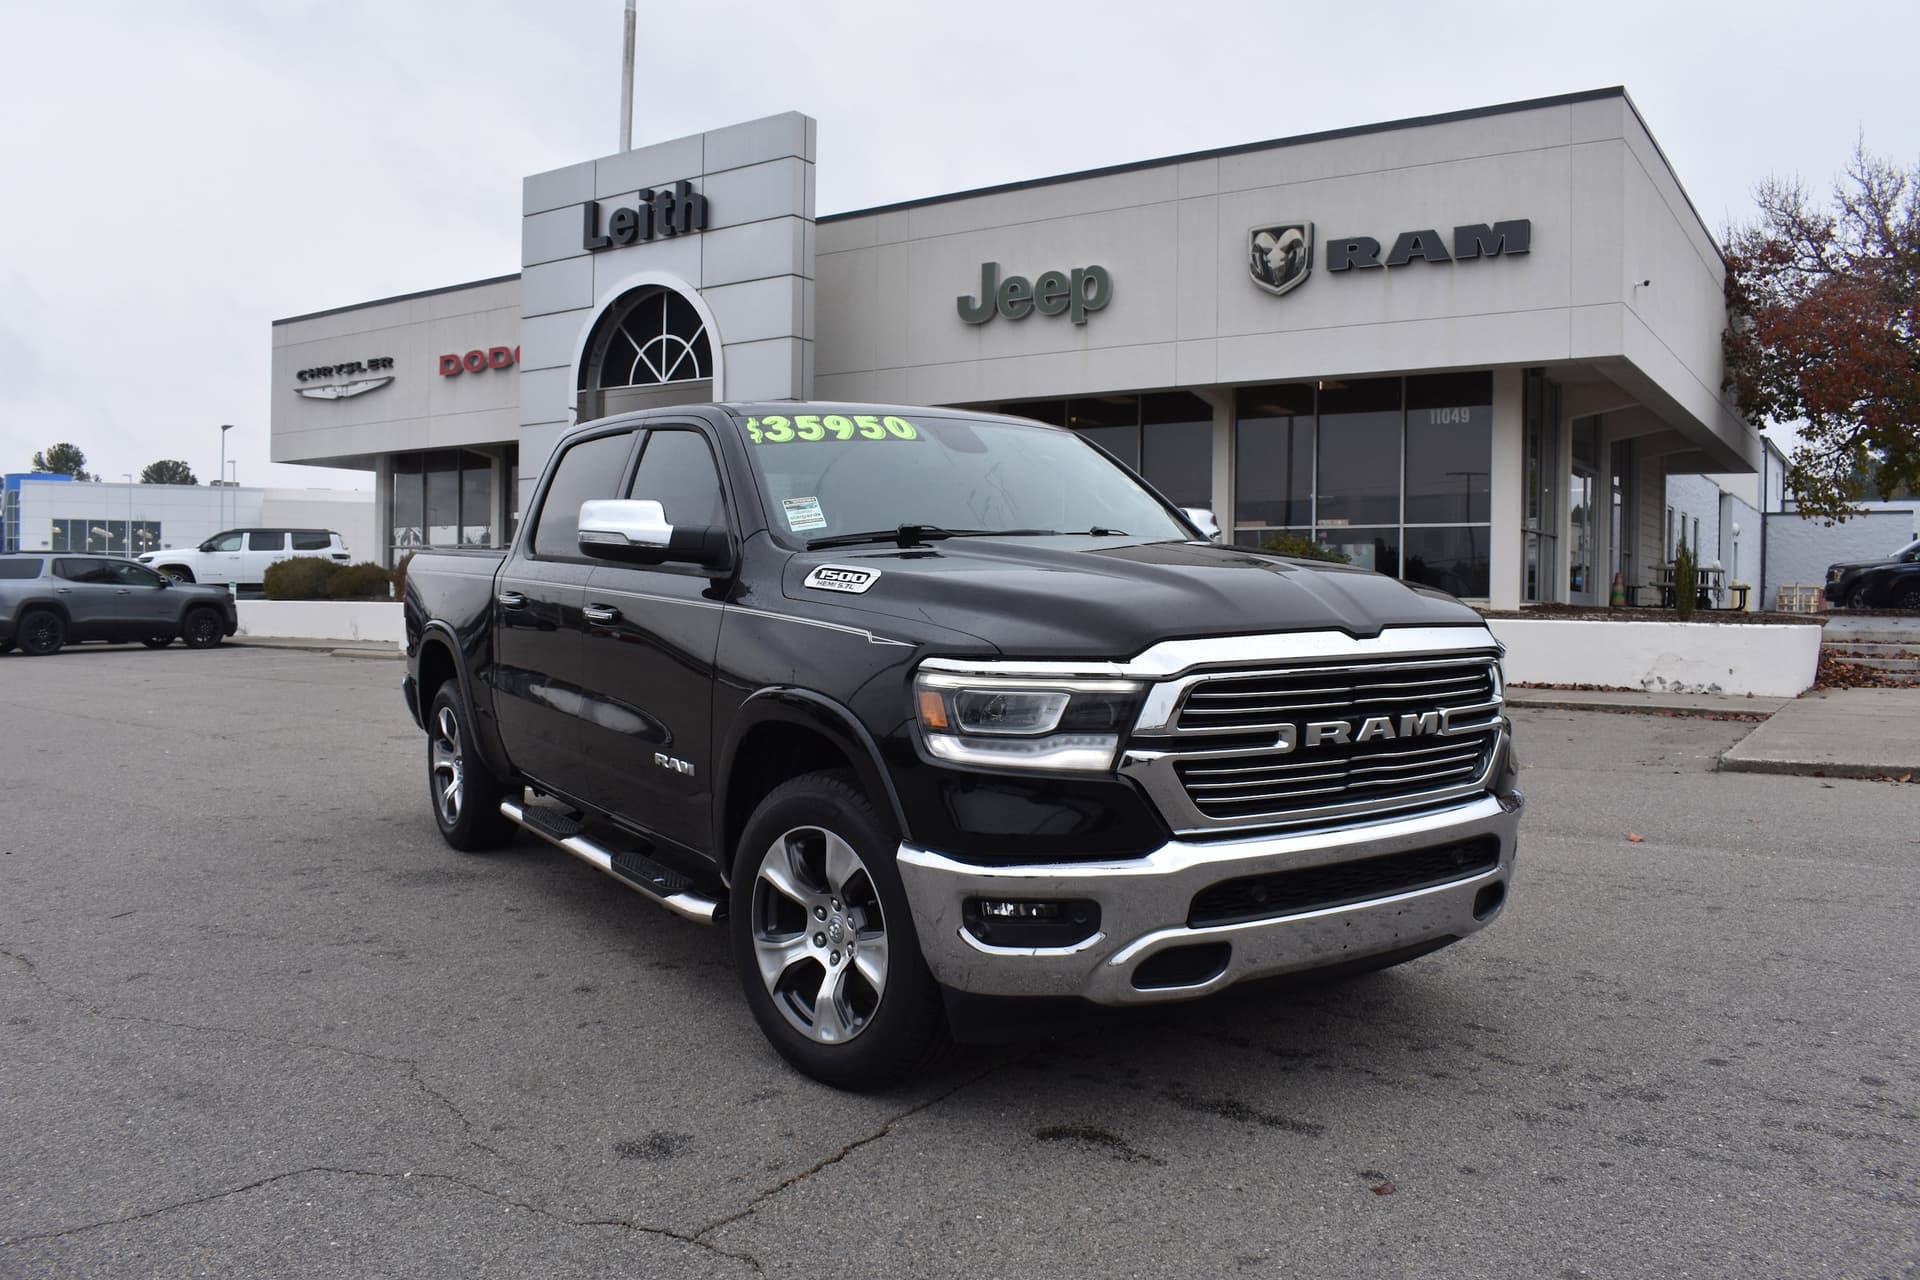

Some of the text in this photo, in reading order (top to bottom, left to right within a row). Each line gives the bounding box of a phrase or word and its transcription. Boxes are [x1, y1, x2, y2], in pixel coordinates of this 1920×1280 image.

[583, 180, 708, 250] Leith
[1326, 219, 1531, 272] RAM
[957, 261, 1113, 325] Jeep
[296, 356, 394, 382] CHRYSLER
[439, 346, 520, 379] DOD
[746, 415, 918, 444] $35950
[1430, 407, 1470, 425] 11049
[816, 580, 836, 588] HEMI
[819, 569, 869, 584] 1500
[1305, 711, 1438, 747] RAM
[655, 752, 695, 777] RAM
